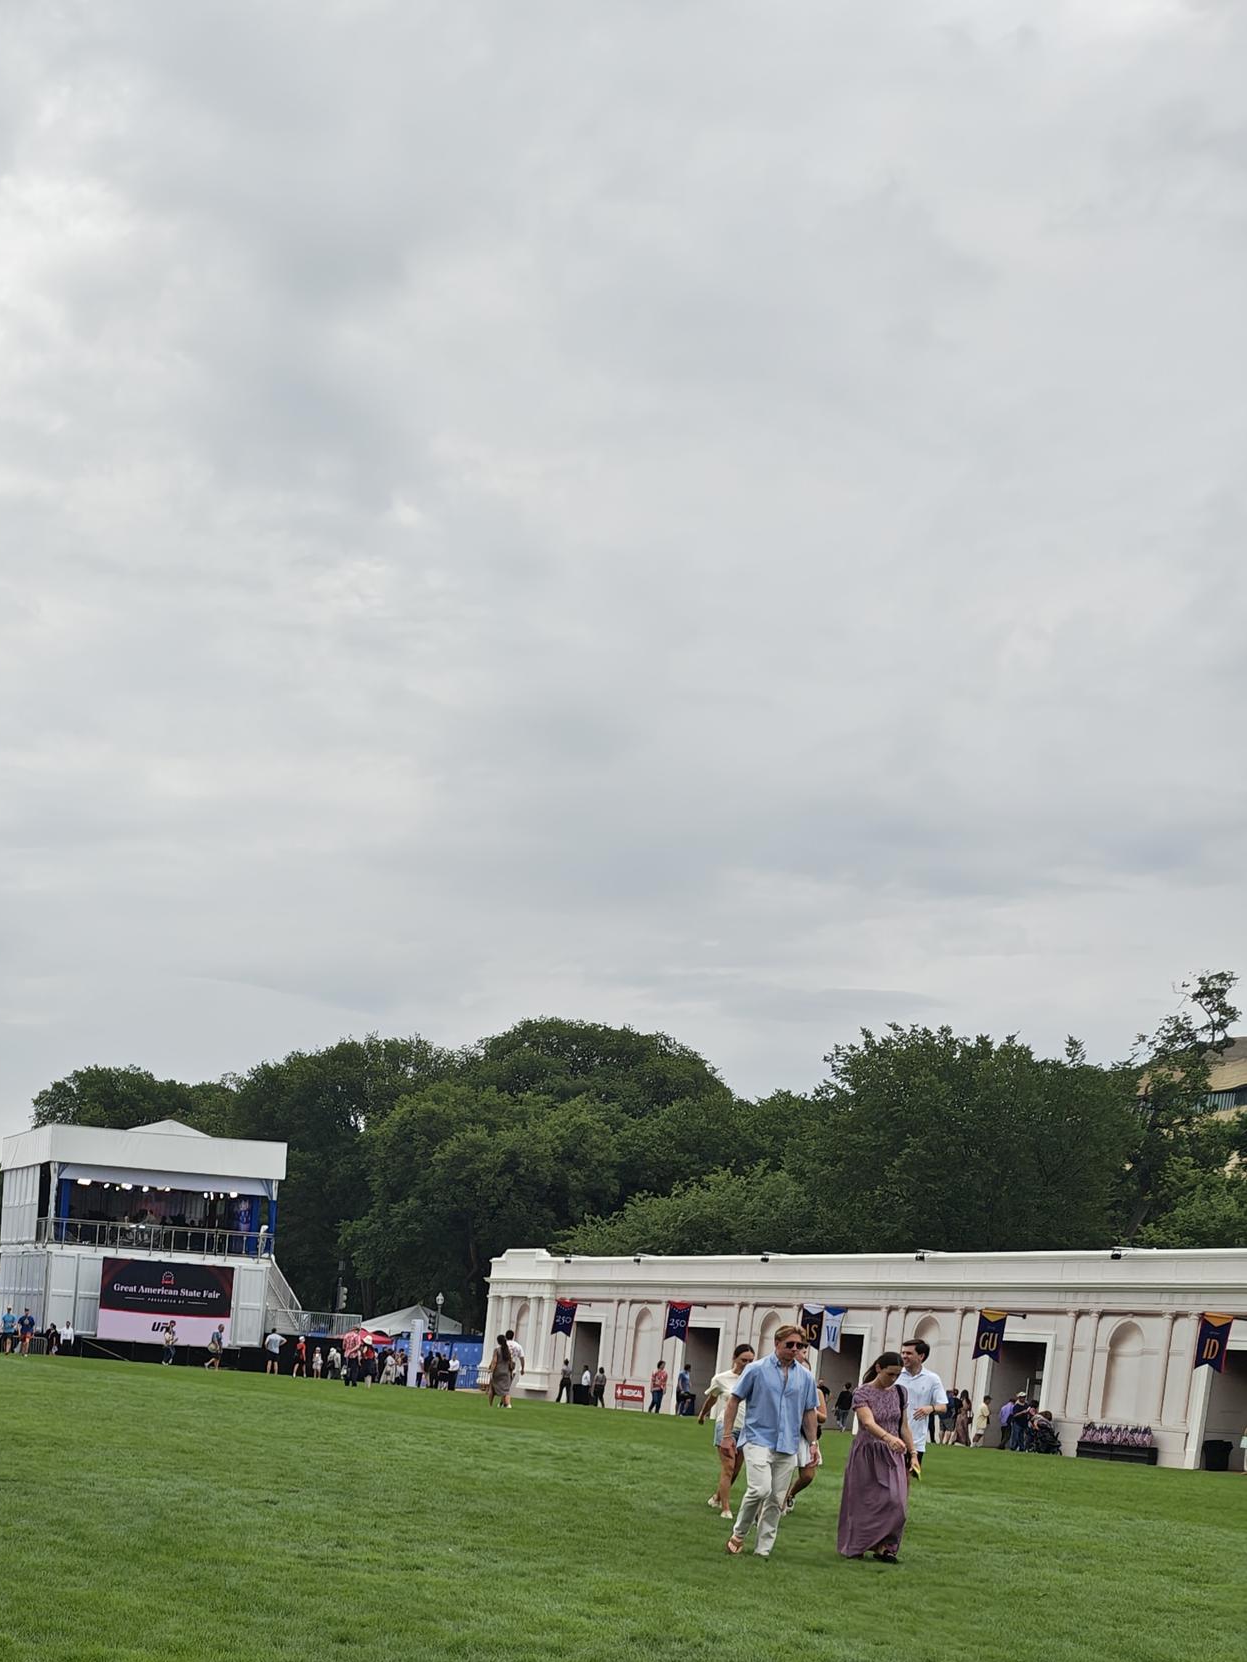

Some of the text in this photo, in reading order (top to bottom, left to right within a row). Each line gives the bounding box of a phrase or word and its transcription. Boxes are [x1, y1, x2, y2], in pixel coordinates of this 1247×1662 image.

[113, 1283, 221, 1300] Great American State Fair
[555, 1315, 572, 1326] 250
[668, 1318, 686, 1330] 250
[826, 1325, 838, 1342] VI
[979, 1332, 999, 1351] GU
[1202, 1338, 1220, 1360] ID
